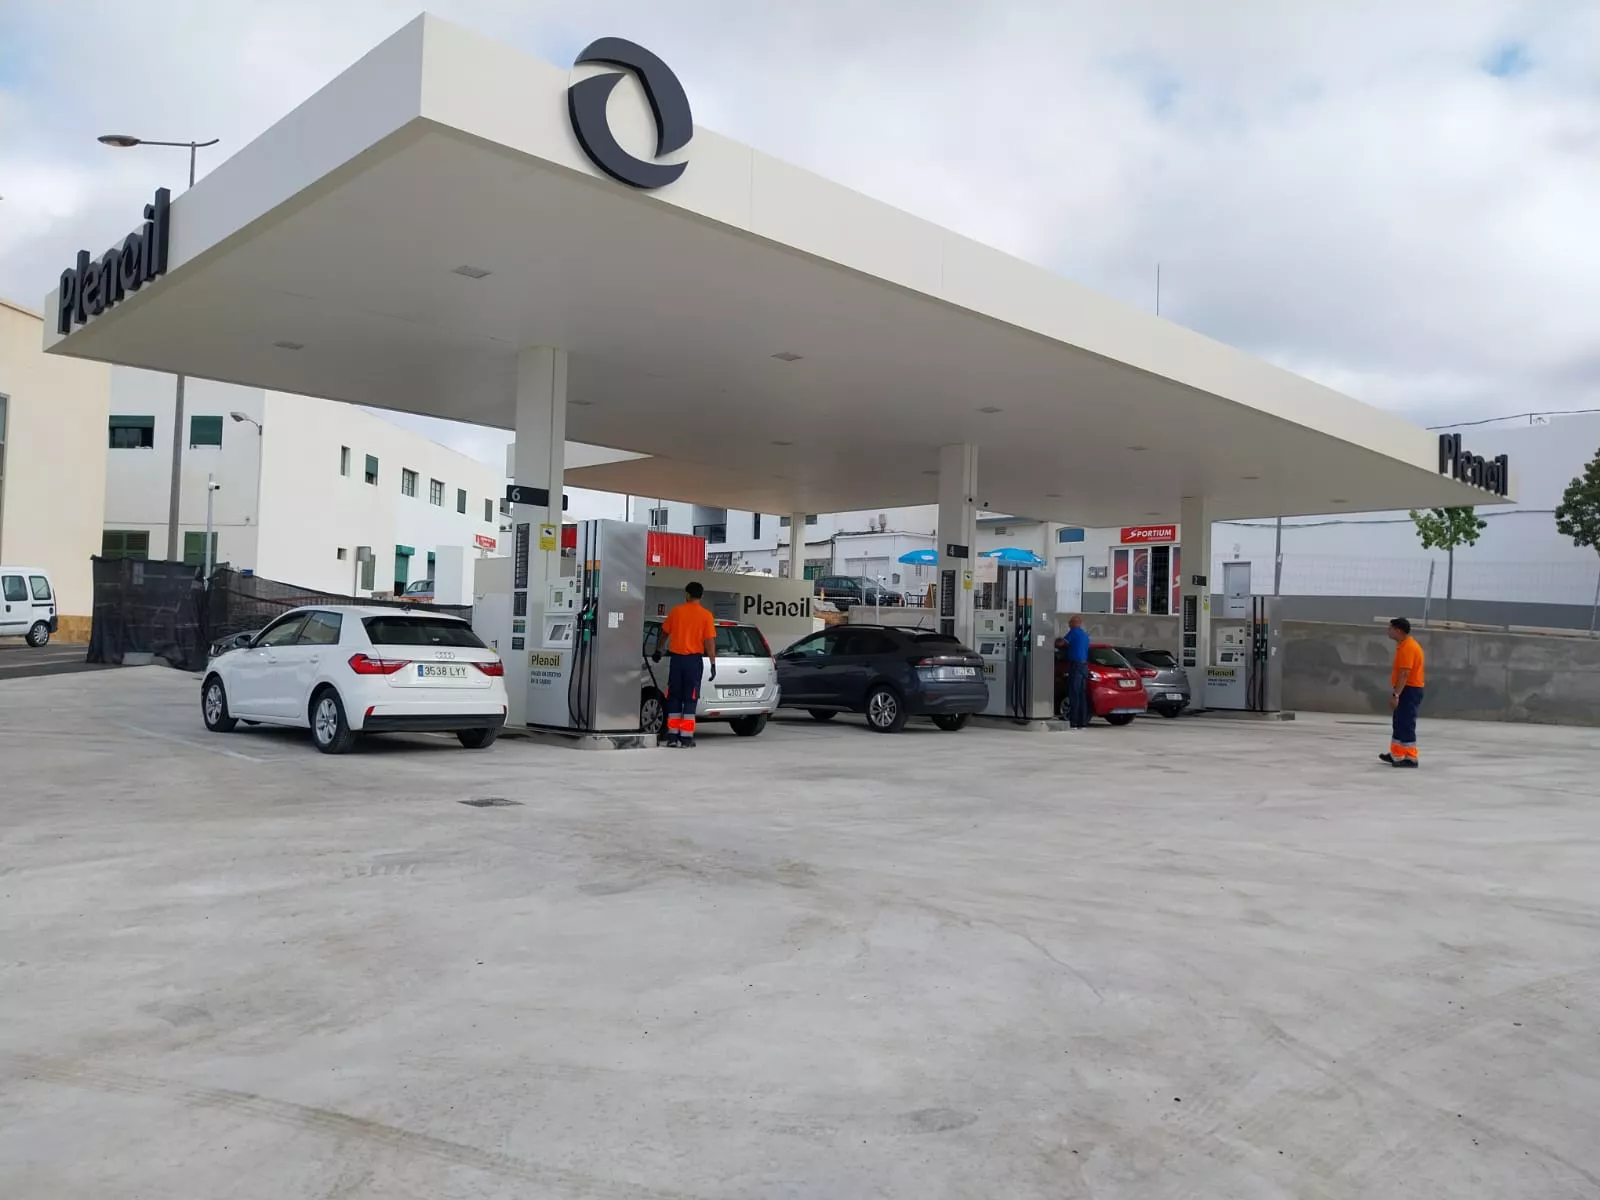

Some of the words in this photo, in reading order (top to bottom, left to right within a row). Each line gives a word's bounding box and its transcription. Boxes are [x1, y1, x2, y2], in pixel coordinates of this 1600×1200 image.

[57, 187, 171, 335] Plenoil
[1439, 433, 1508, 496] Plenoil
[511, 487, 521, 502] 6
[1126, 529, 1172, 540] SPORTIUM
[743, 593, 811, 617] Plenoil
[531, 653, 560, 667] Plenoil
[424, 665, 448, 676] 3538
[449, 666, 467, 677] LYY
